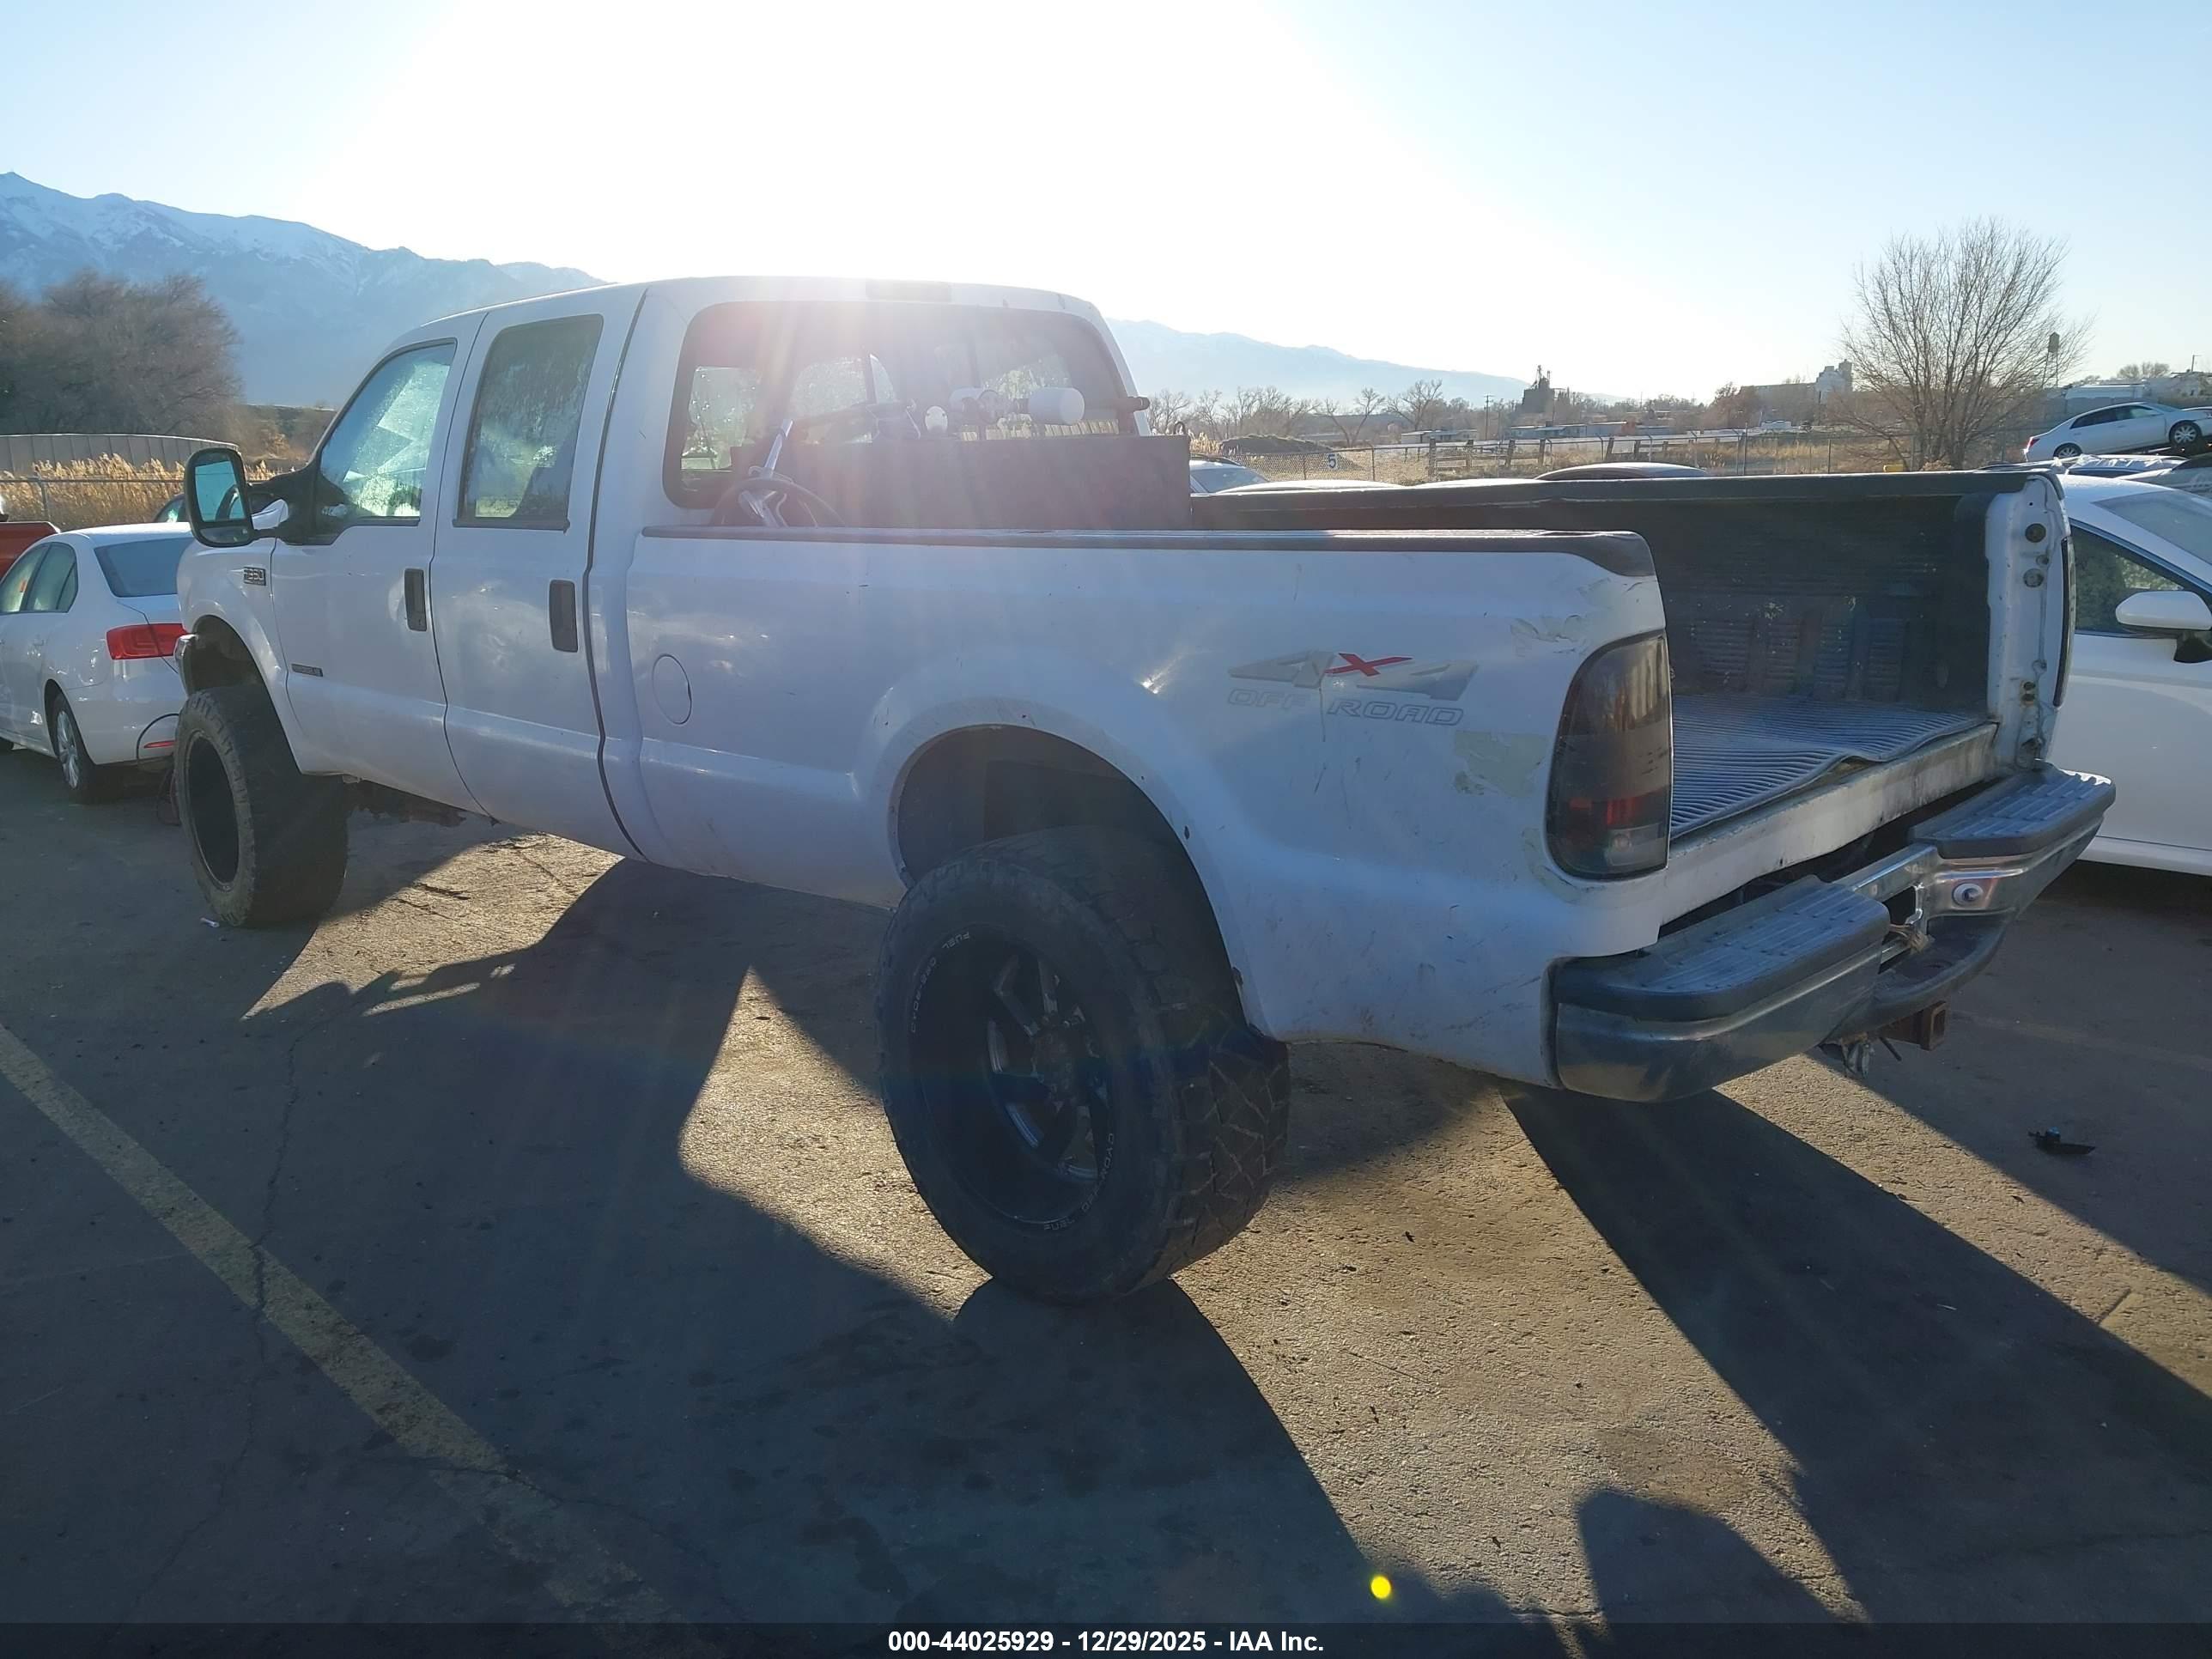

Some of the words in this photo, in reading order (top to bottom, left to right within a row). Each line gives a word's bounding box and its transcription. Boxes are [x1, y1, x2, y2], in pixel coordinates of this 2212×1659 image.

[1328, 454, 1336, 468] 5
[1227, 689, 1310, 709] OFF
[1327, 698, 1463, 726] ROAD
[941, 931, 969, 949] FUEL
